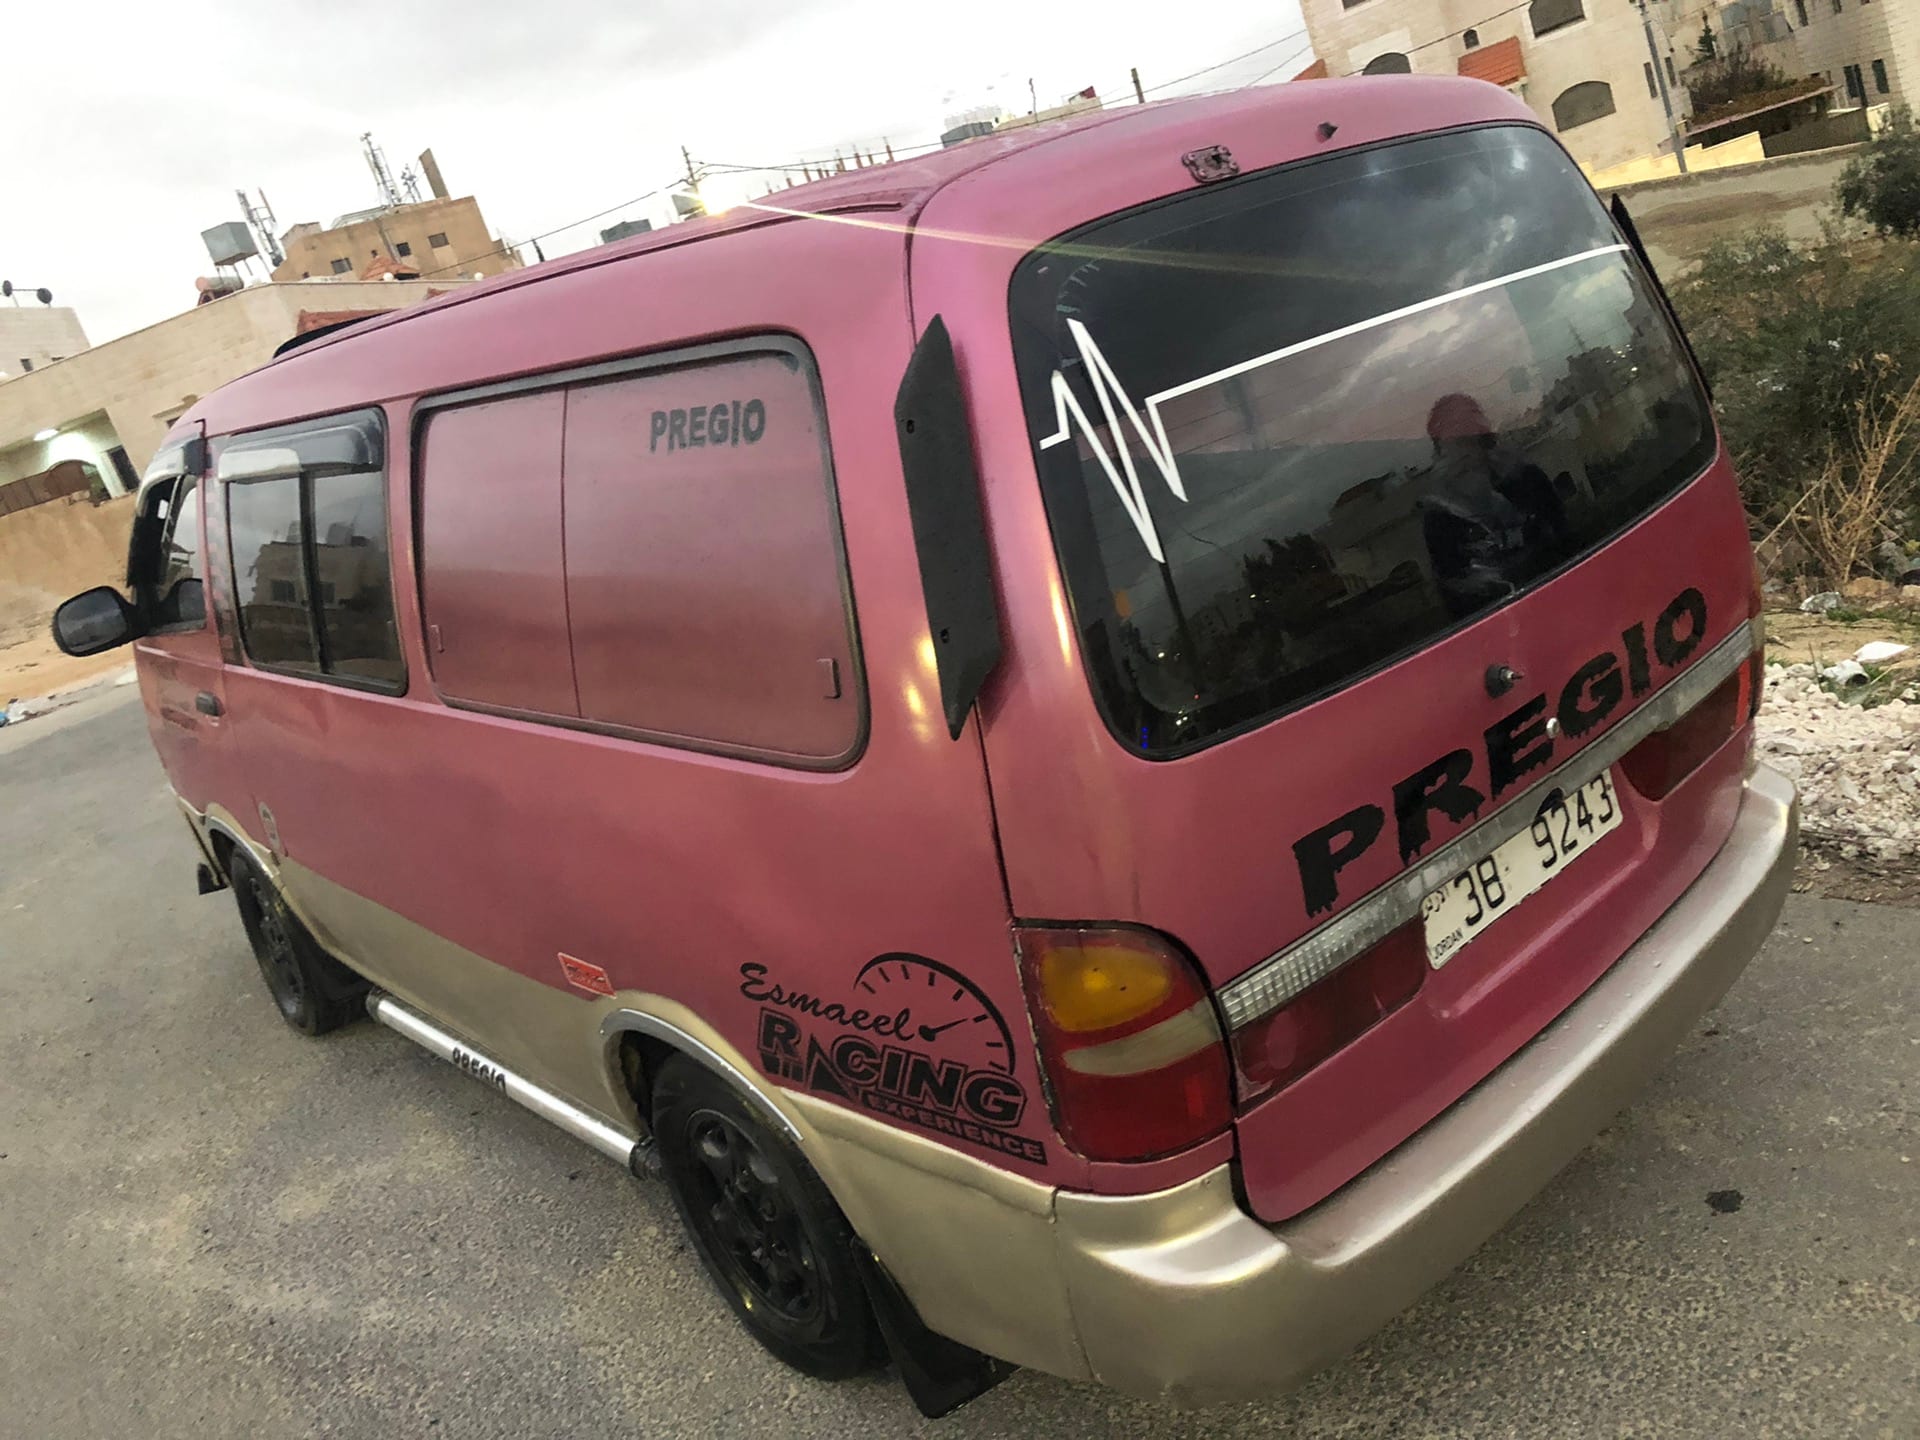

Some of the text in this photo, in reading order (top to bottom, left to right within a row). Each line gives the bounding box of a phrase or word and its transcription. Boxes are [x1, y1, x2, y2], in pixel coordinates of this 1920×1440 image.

[650, 399, 765, 453] PREGIO
[1292, 587, 1707, 918] PREGIO
[1454, 774, 1614, 926] 38 9243
[1433, 927, 1464, 960] JORDAN
[740, 962, 915, 1042] Esmaeel
[757, 1006, 1028, 1128] RACING
[866, 1095, 1048, 1165] EXPERIENCE
